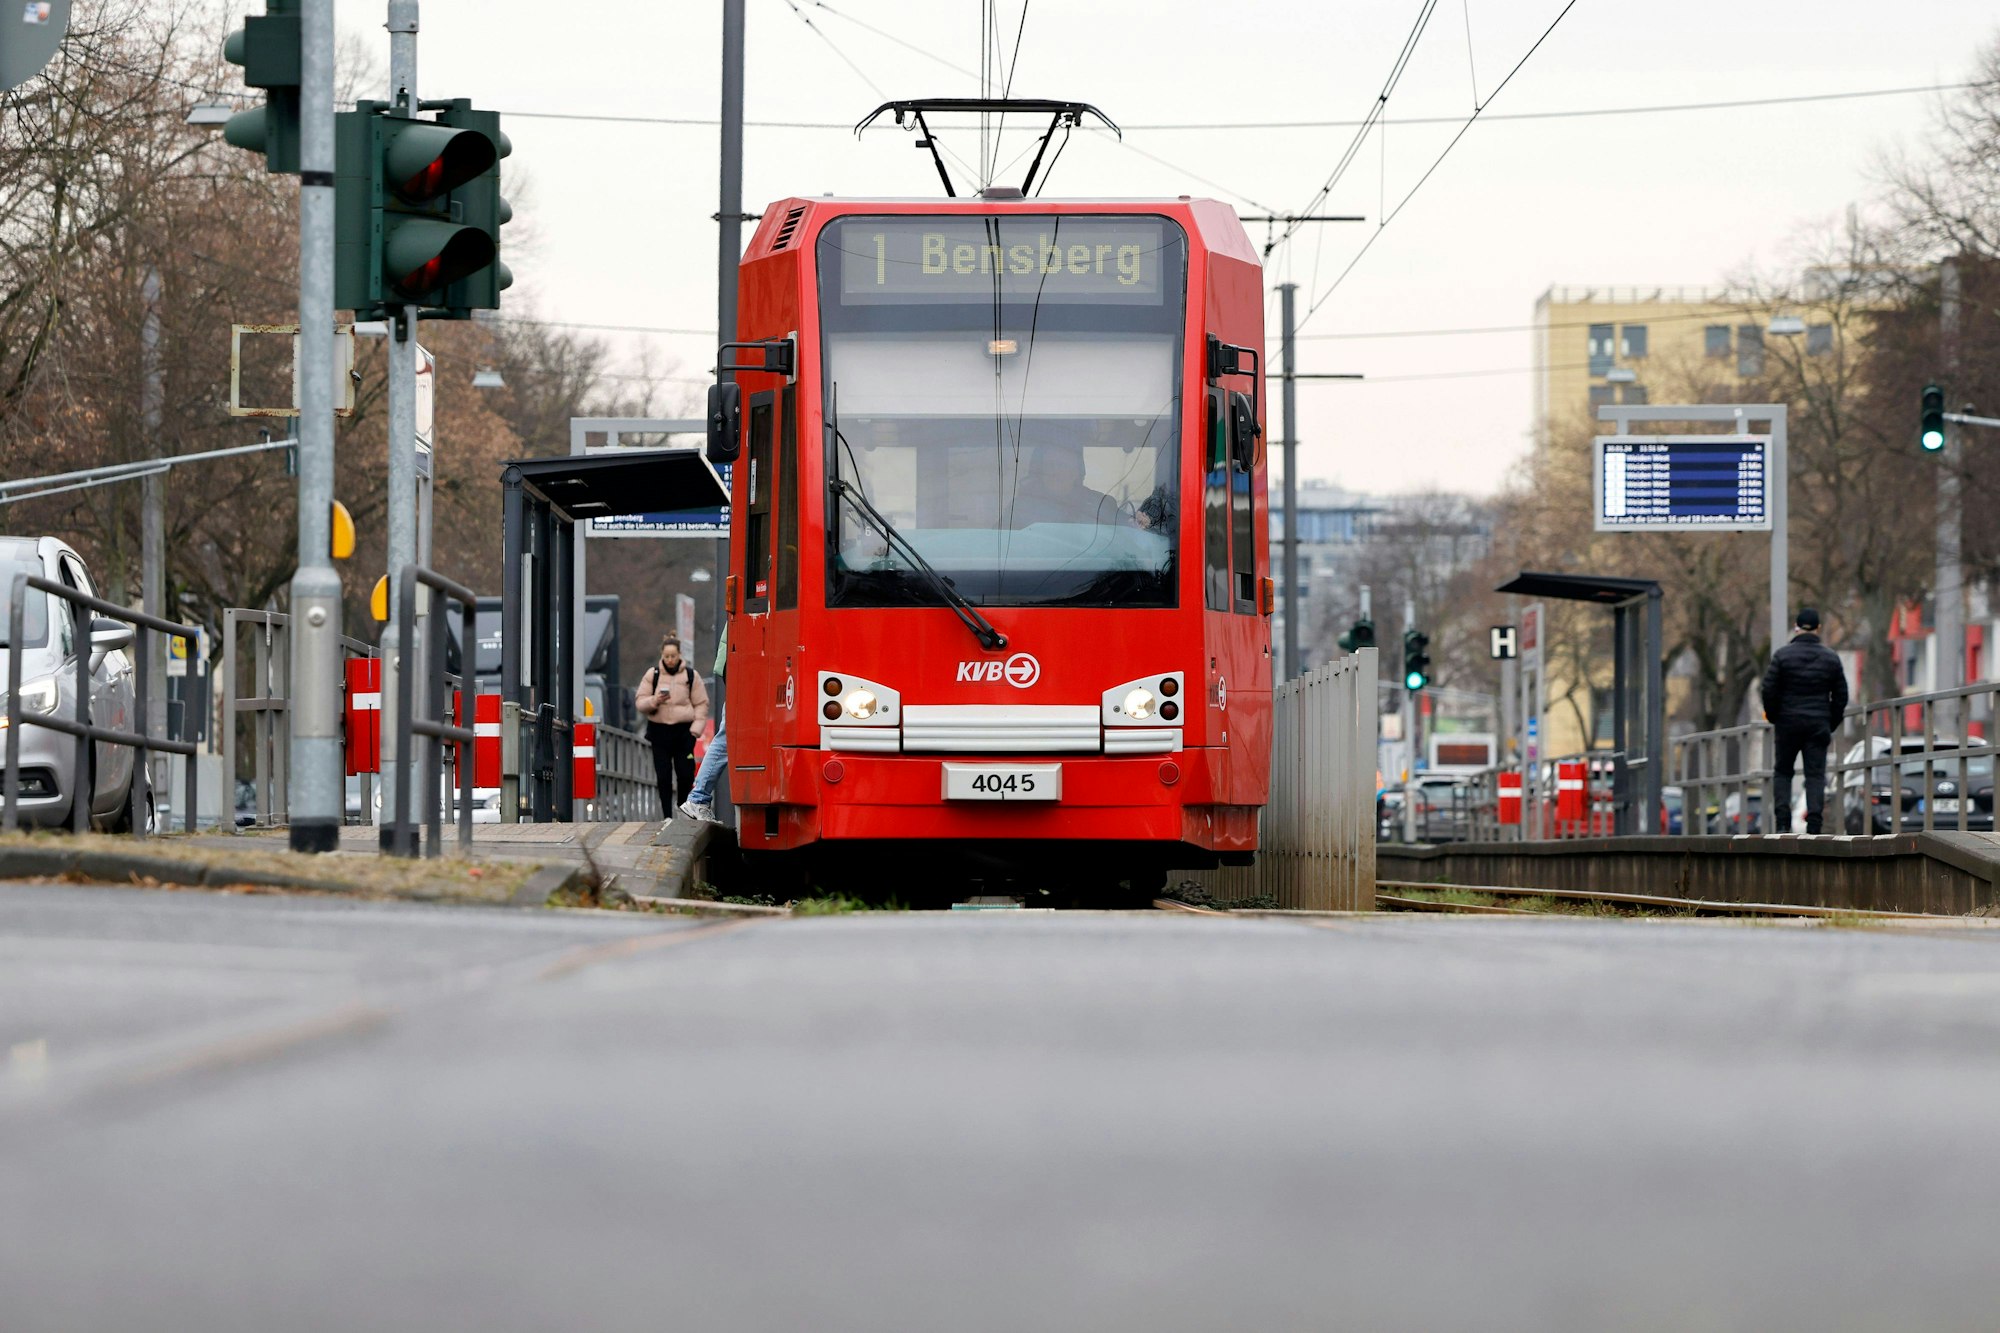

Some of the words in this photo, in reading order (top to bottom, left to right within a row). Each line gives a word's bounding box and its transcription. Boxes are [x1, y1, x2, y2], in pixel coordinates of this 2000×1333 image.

[873, 233, 885, 284] 1
[922, 233, 1140, 285] Bensberg
[636, 522, 655, 530] Linien
[1491, 628, 1516, 657] H
[956, 661, 1004, 682] KVB
[972, 773, 1035, 793] 4045
